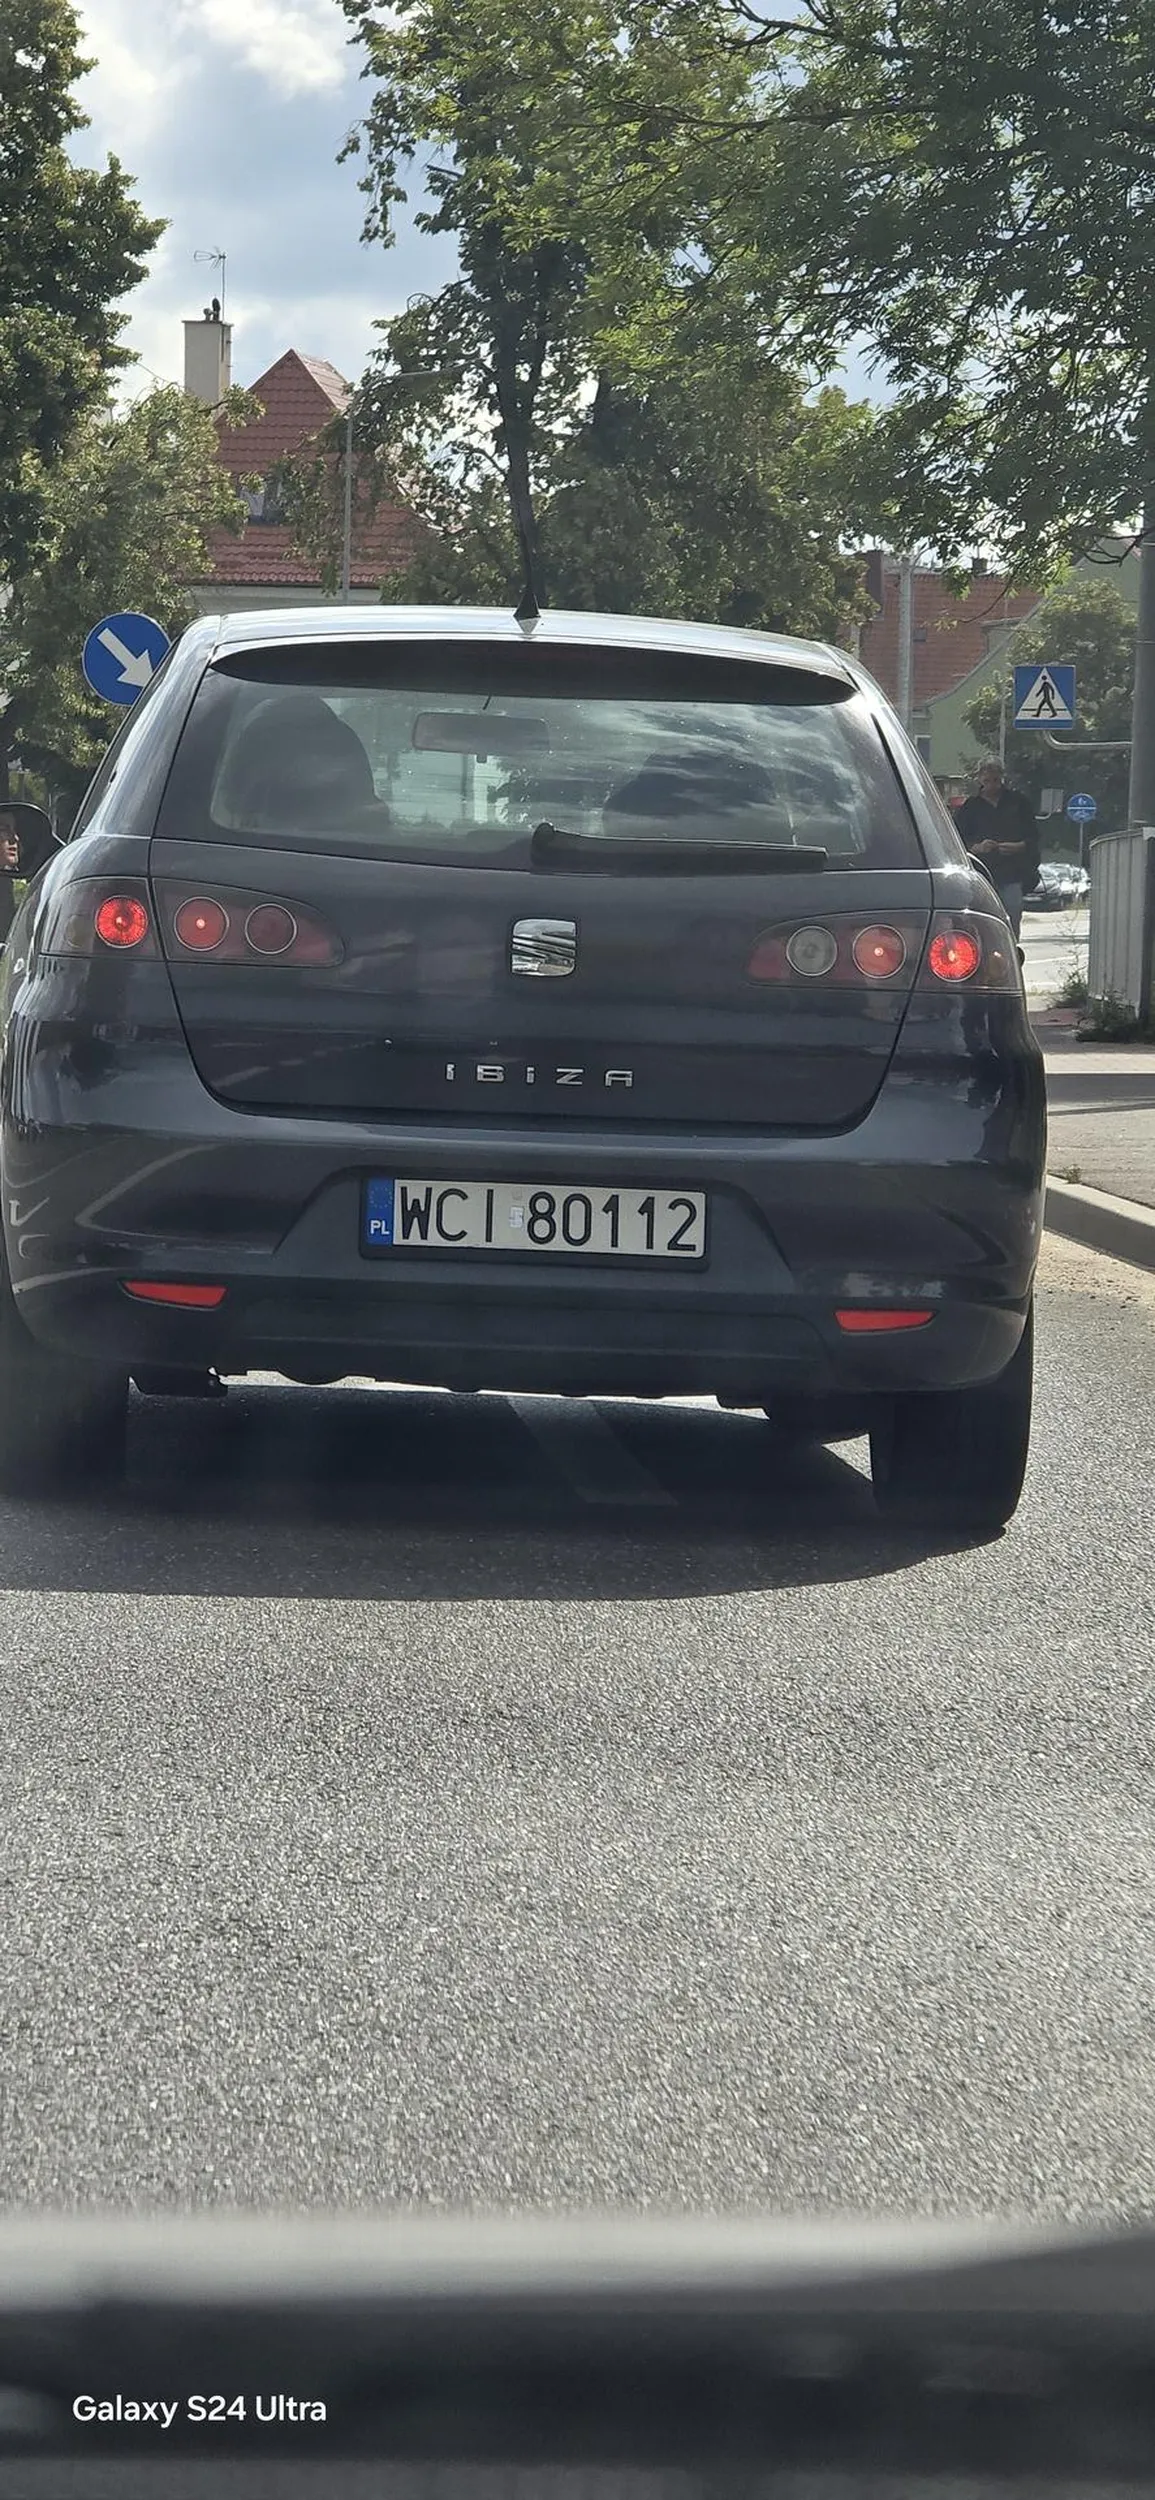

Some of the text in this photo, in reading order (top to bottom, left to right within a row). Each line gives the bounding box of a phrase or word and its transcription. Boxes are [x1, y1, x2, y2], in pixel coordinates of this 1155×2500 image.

[446, 1063, 633, 1087] IBIZA
[370, 1219, 390, 1235] PL
[400, 1186, 698, 1252] WCI 80112
